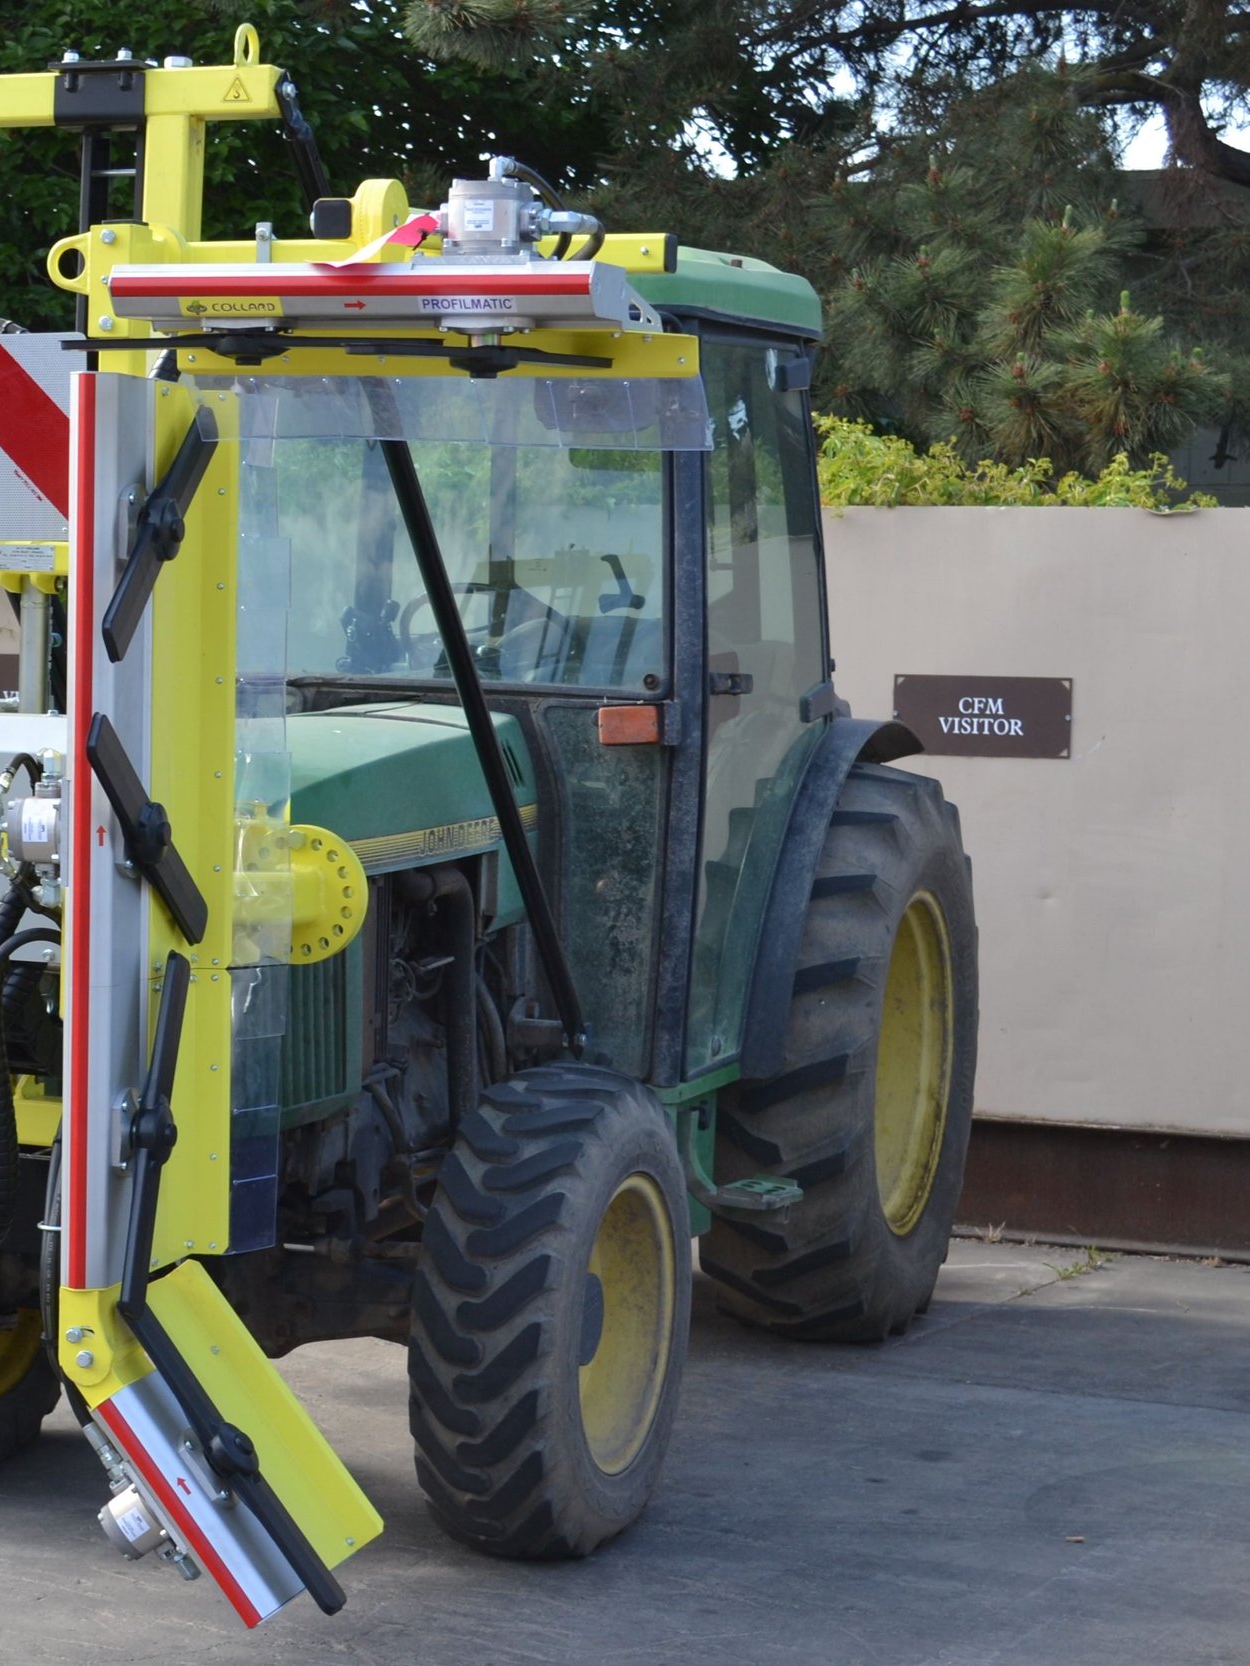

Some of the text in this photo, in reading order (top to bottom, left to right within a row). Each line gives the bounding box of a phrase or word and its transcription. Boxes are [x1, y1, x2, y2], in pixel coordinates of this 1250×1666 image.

[211, 302, 276, 312] COLLARD
[422, 298, 513, 310] PROFILMATIC
[958, 697, 1005, 715] CFM
[938, 717, 1024, 736] VISITOR
[420, 818, 496, 856] JOHN DEERE
